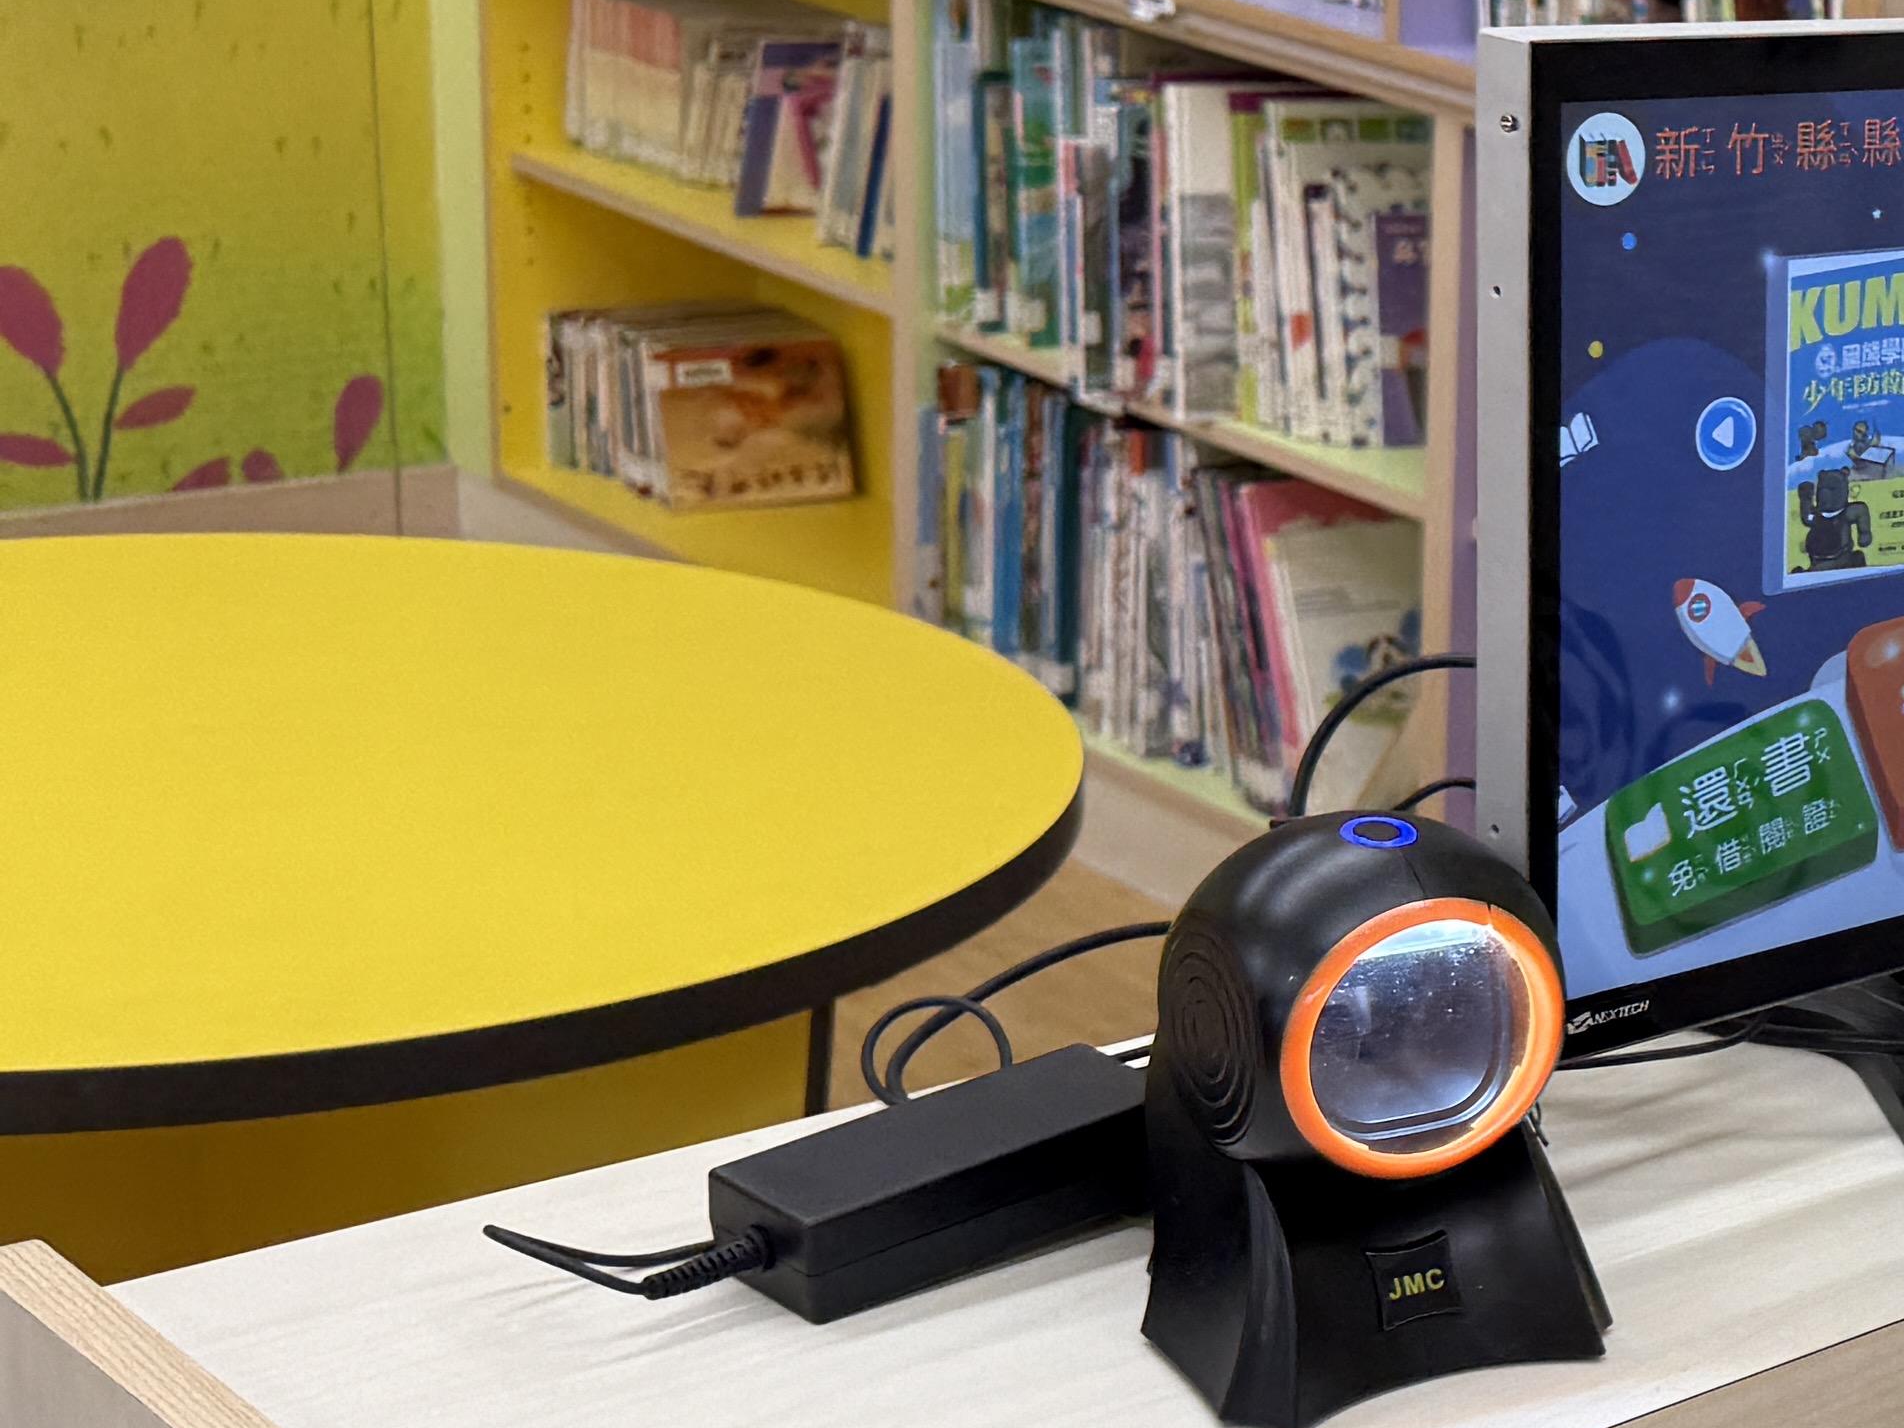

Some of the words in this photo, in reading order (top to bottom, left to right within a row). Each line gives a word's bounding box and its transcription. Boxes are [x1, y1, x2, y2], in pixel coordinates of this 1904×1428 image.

[1677, 727, 1830, 839] 還書
[1667, 795, 1841, 898] 免借閱證
[1389, 1268, 1445, 1300] JMC
